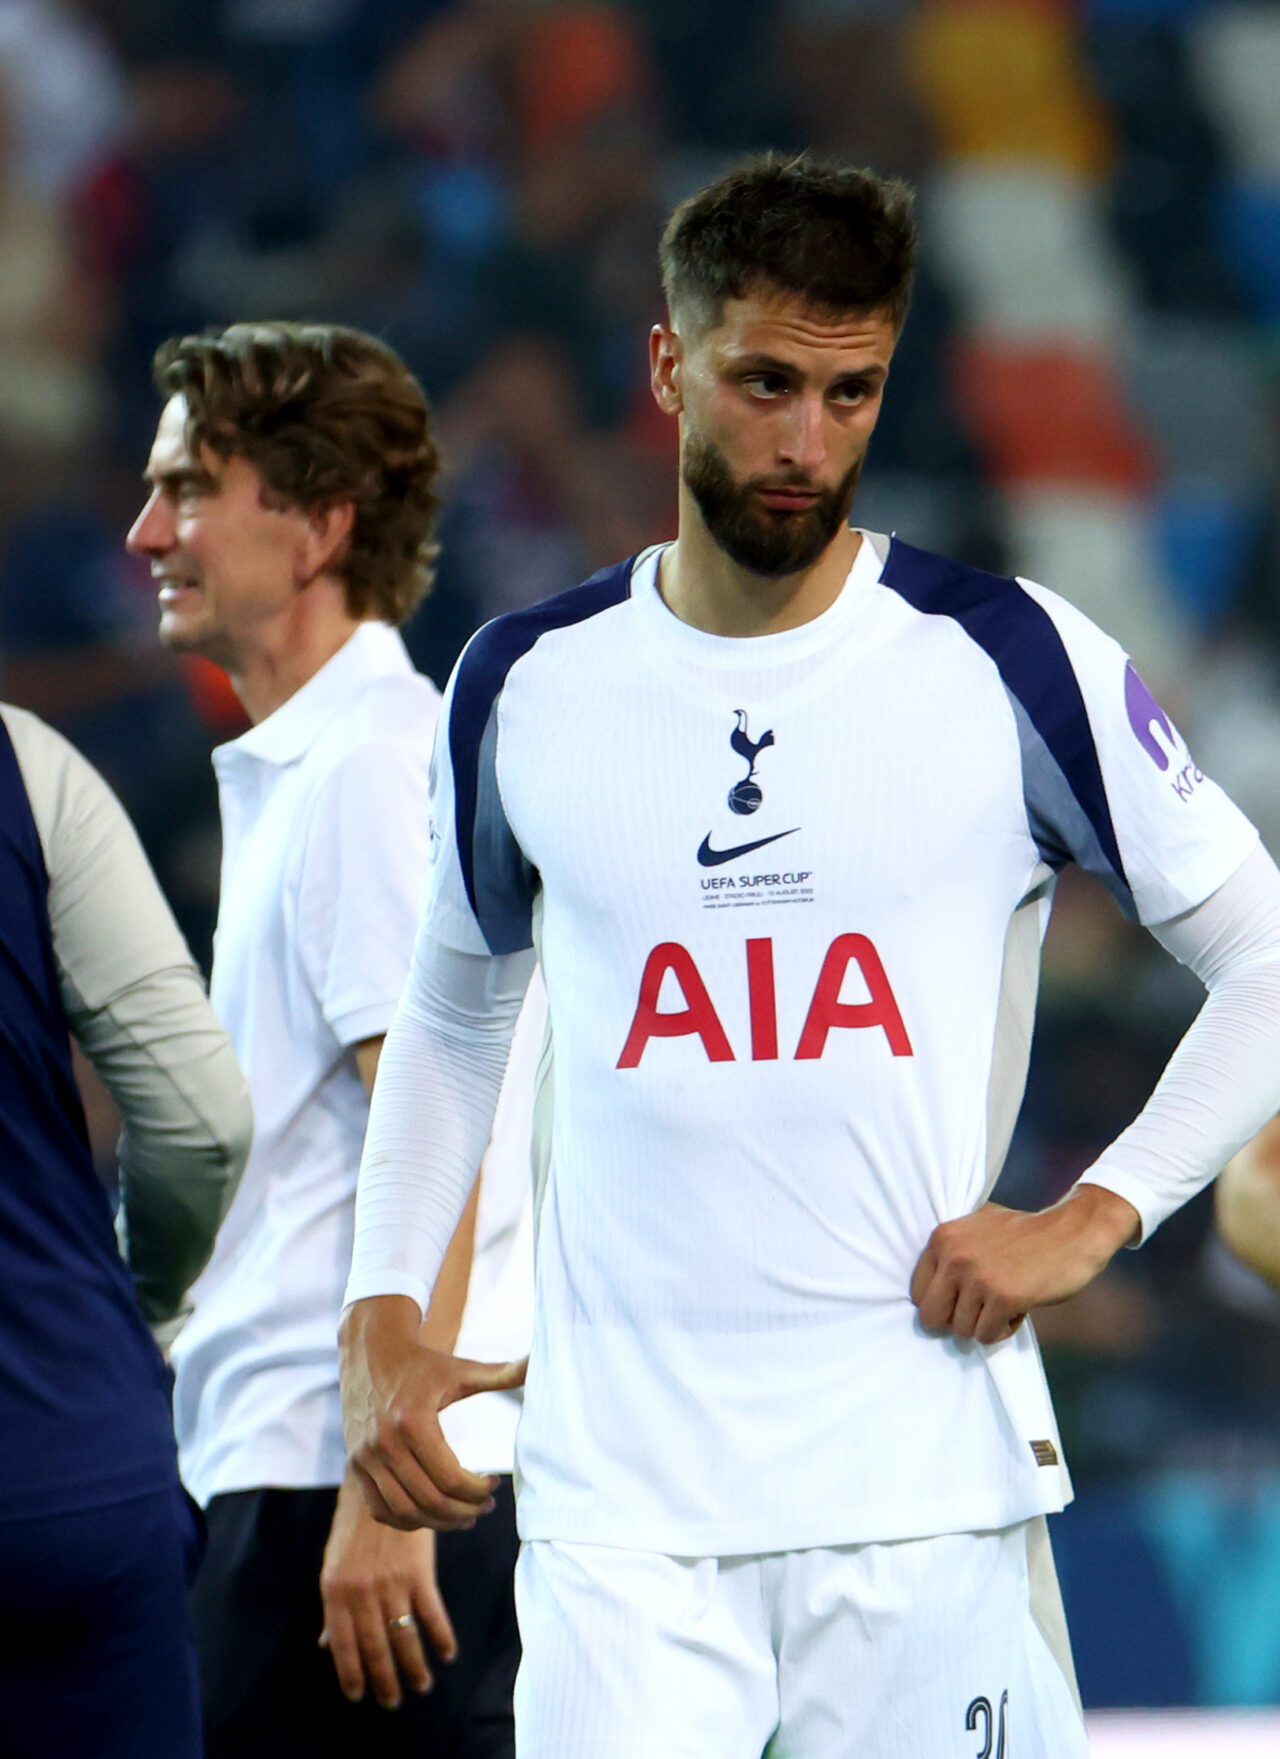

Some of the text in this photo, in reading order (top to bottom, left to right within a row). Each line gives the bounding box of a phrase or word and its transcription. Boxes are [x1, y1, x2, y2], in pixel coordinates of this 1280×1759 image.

[700, 877, 736, 890] UEFA
[739, 874, 781, 888] SUPER
[615, 932, 914, 1069] AIA
